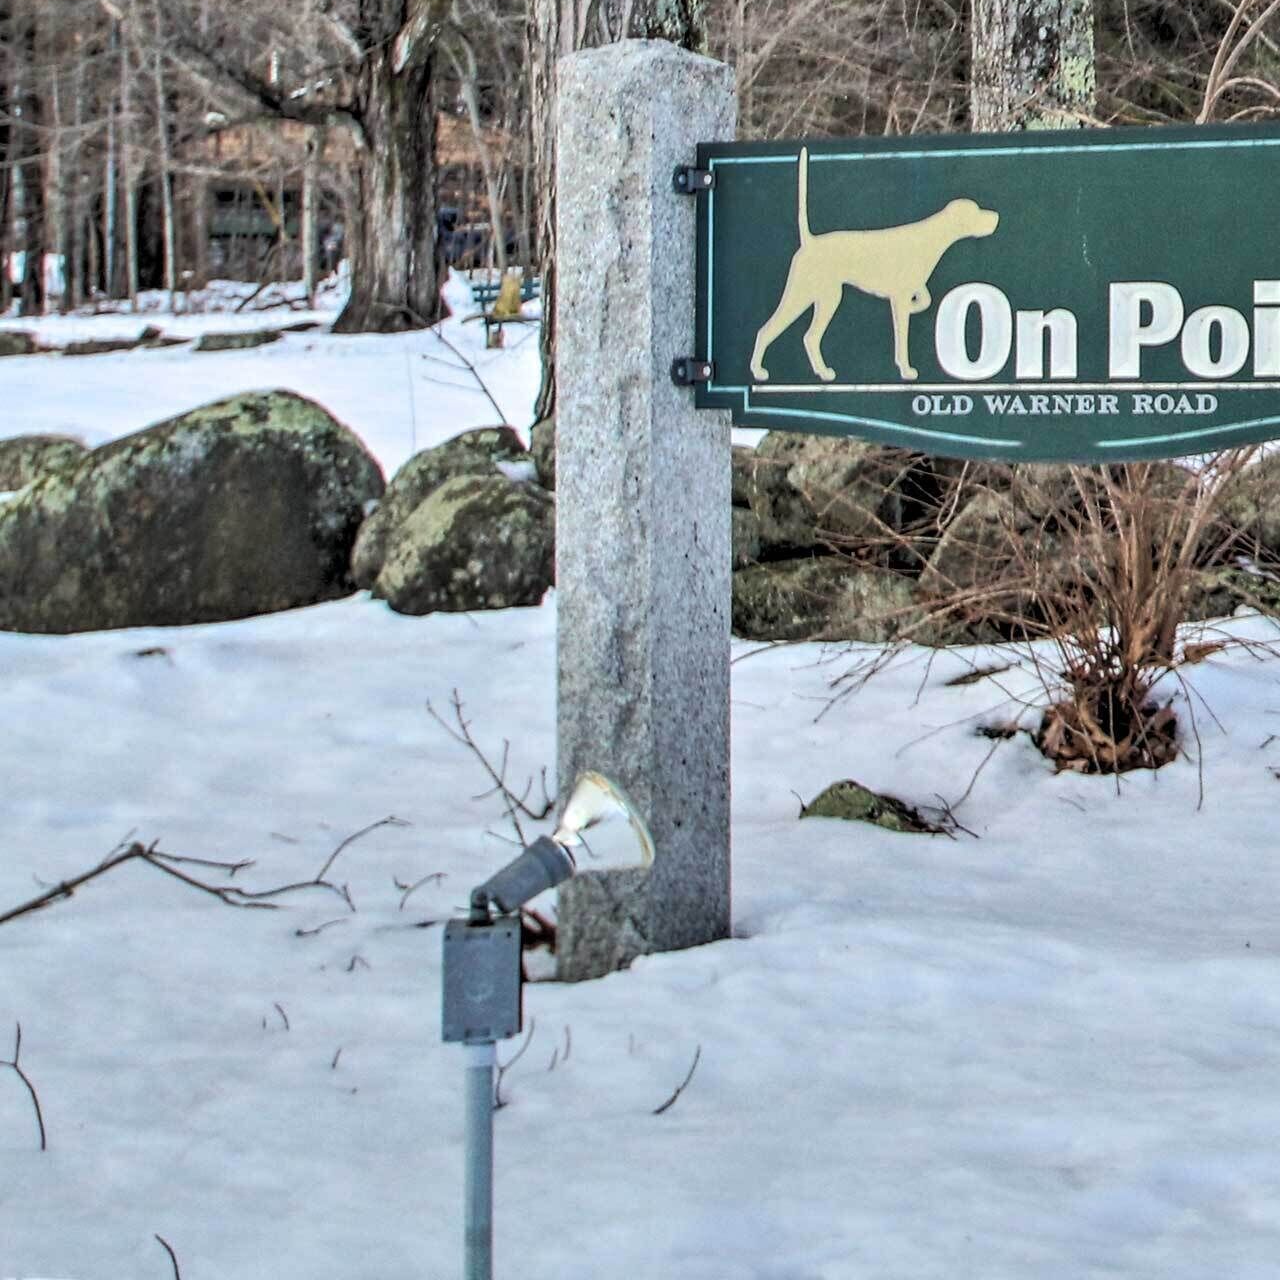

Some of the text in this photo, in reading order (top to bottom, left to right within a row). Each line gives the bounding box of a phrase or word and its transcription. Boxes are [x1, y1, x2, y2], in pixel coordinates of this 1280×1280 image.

[934, 282, 1077, 381] On
[911, 393, 1219, 416] OLD WARNER ROAD
